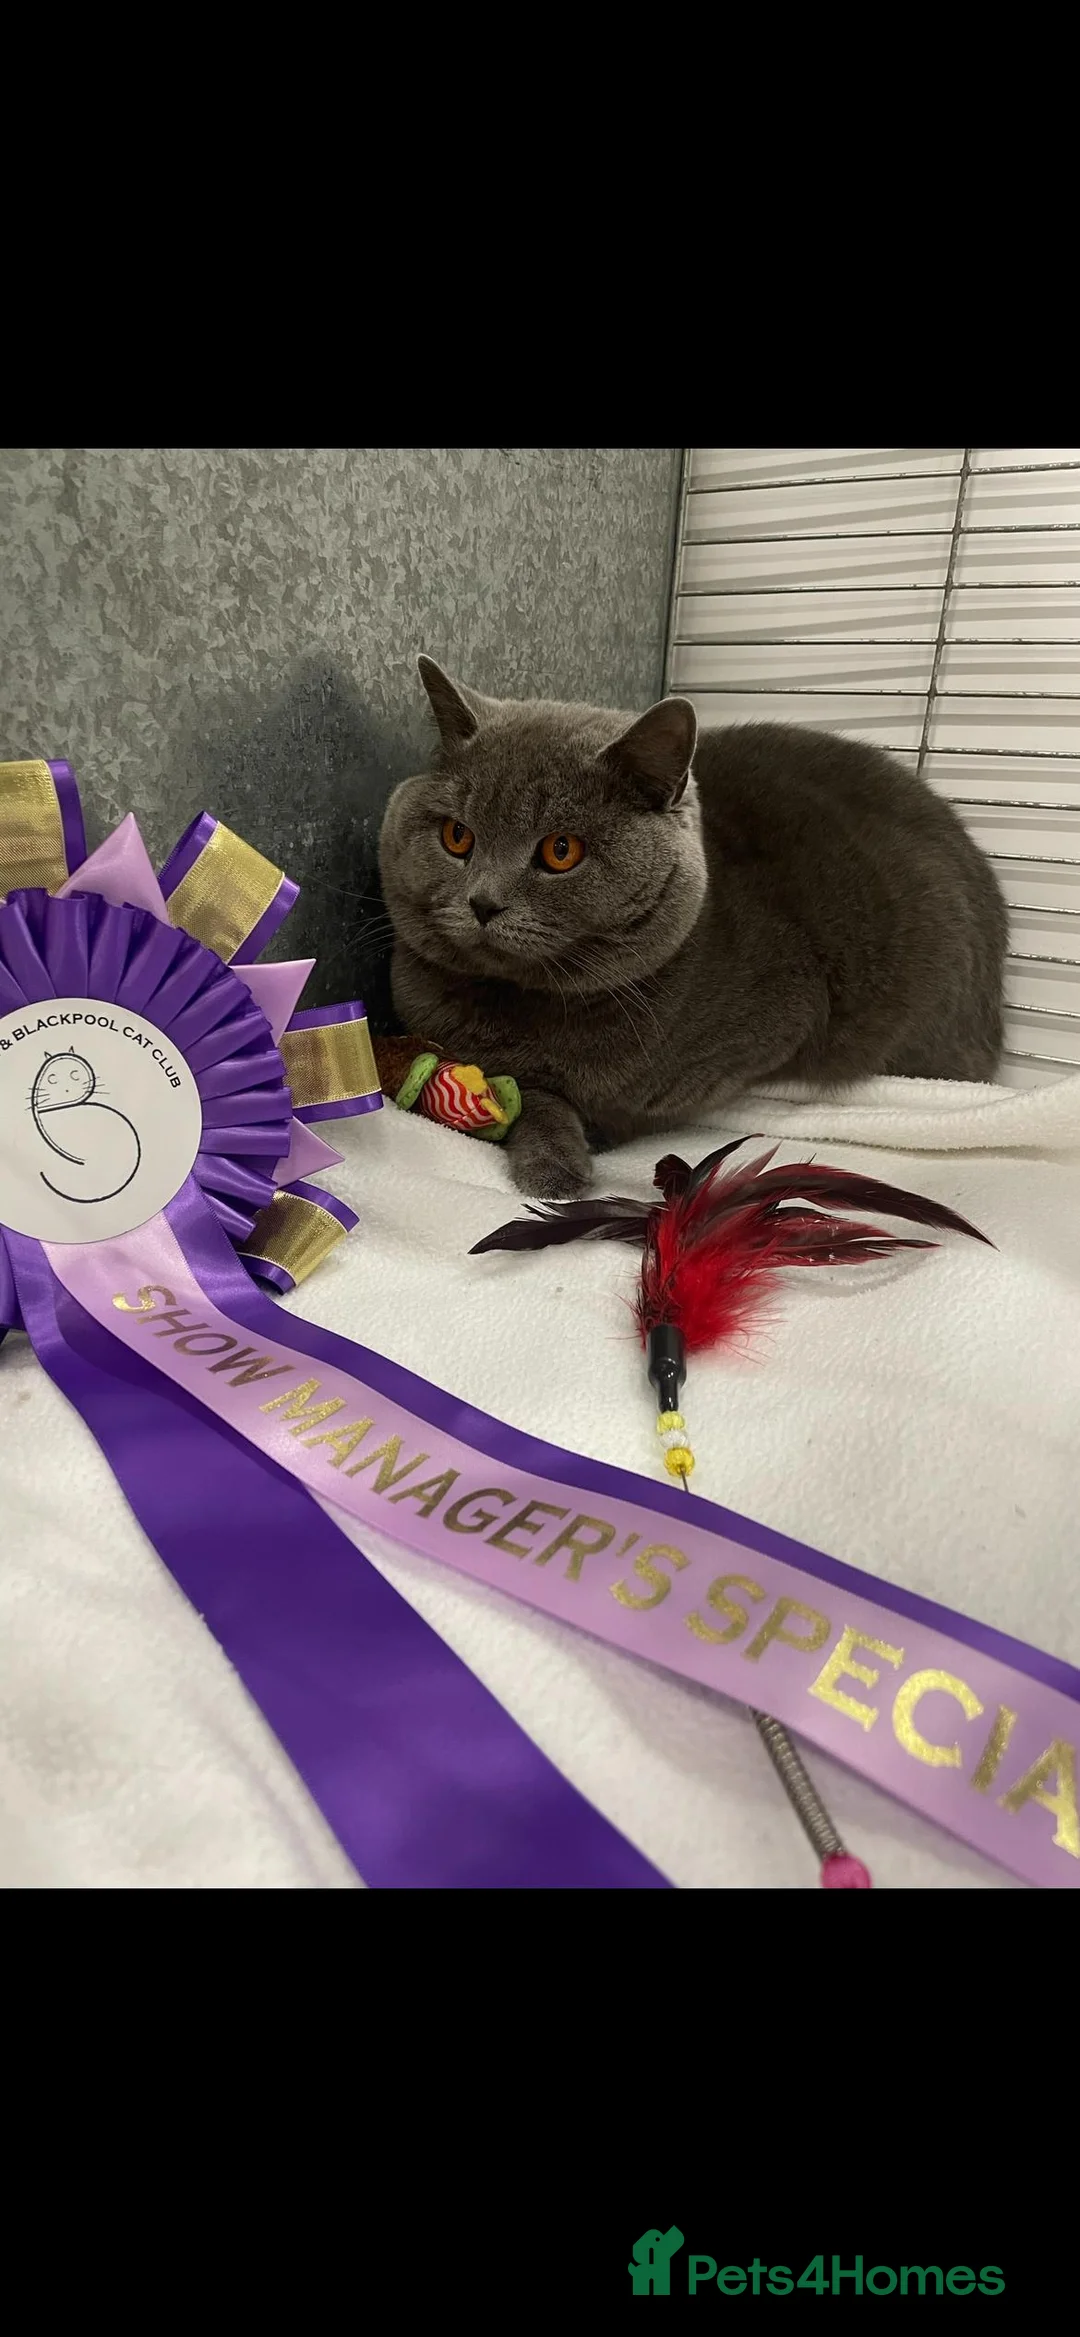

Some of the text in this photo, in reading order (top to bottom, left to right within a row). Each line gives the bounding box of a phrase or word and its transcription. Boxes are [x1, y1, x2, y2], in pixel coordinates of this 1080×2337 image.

[0, 1013, 182, 1089] & BLACKPOOL CAT CLUB
[112, 1284, 295, 1388] SHOW
[258, 1377, 692, 1612] MANAGER'S
